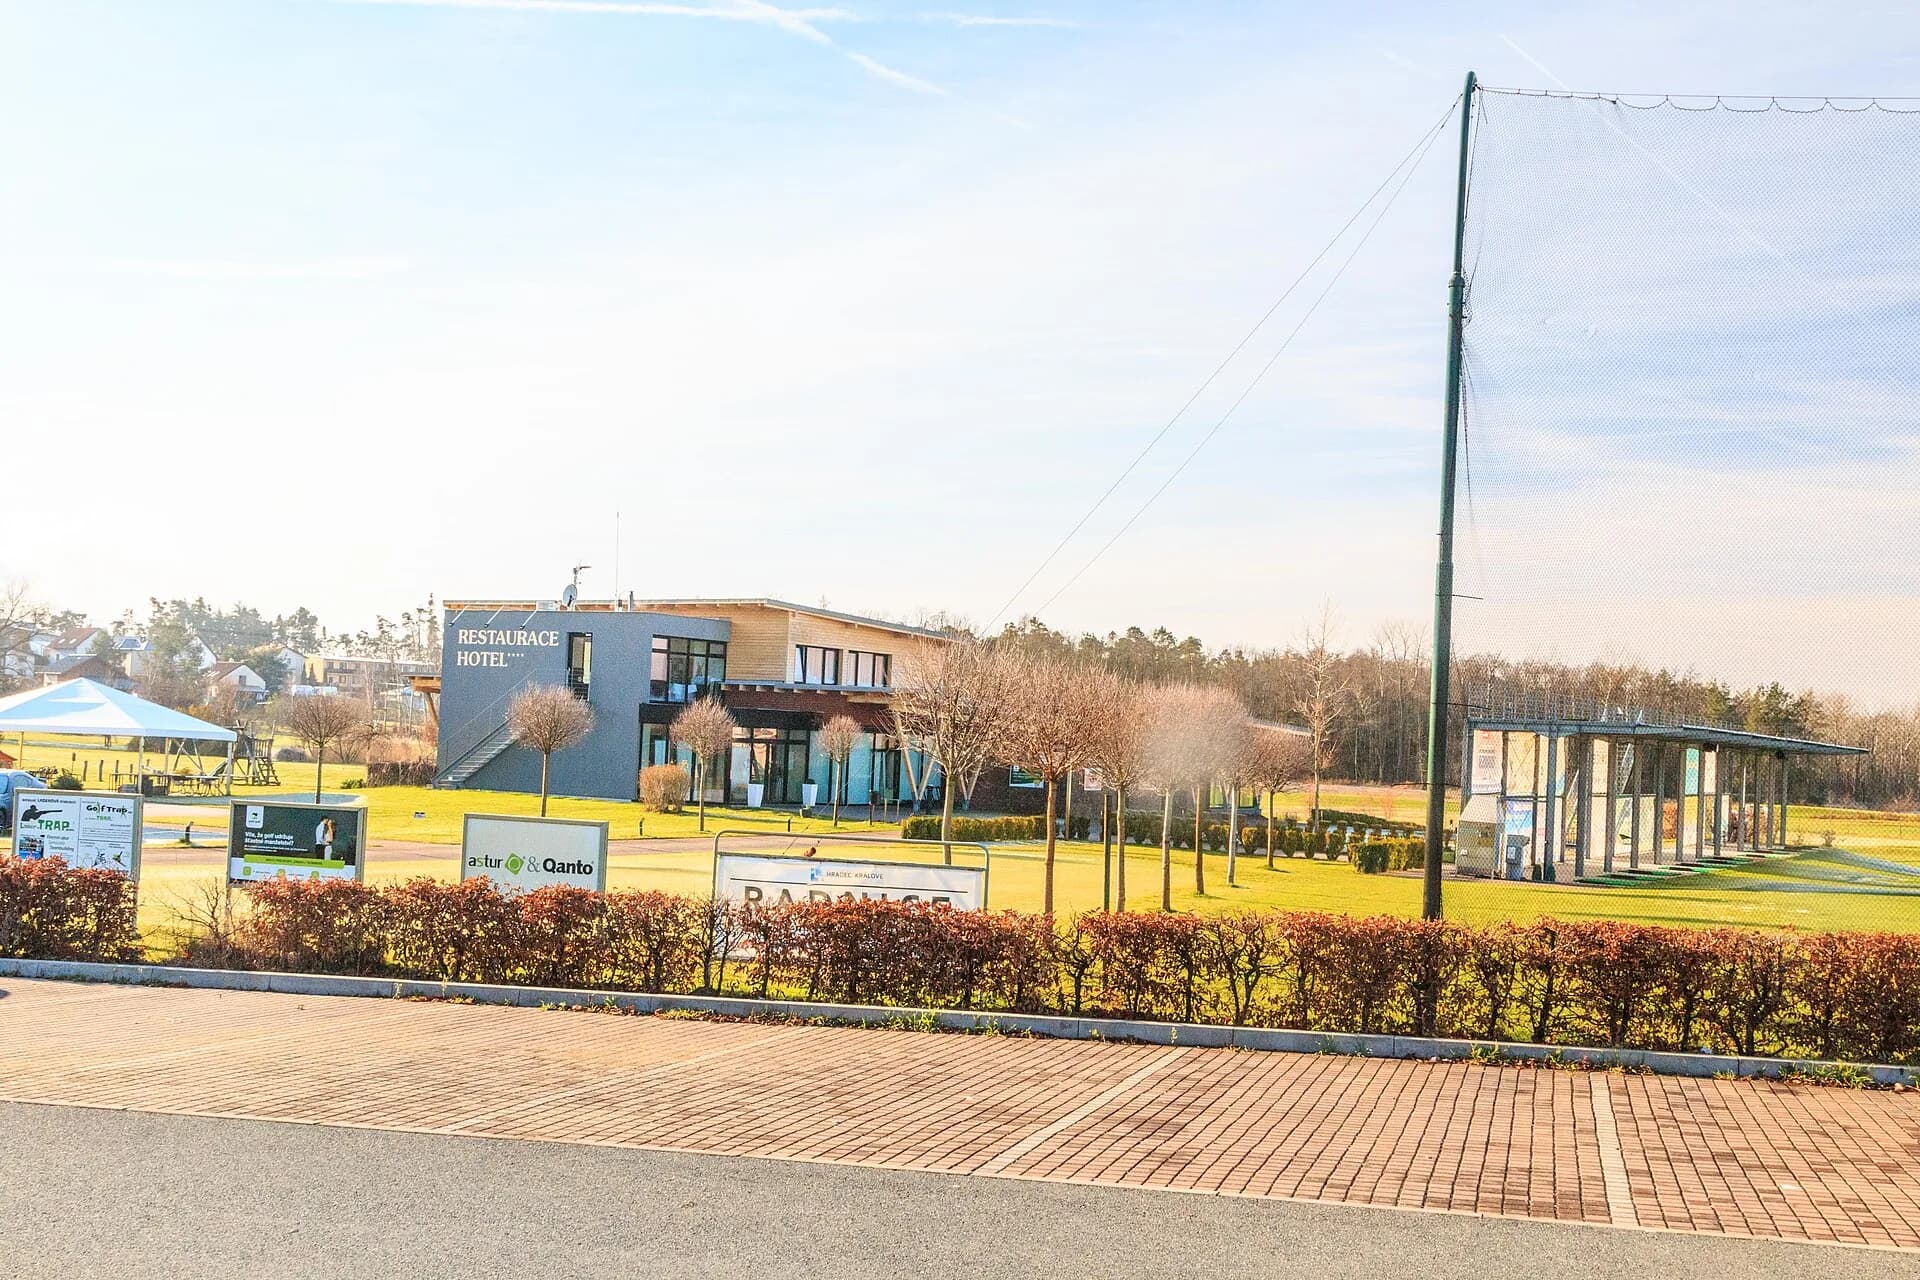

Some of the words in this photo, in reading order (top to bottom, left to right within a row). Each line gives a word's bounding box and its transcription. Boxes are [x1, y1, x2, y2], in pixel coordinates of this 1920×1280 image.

[458, 629, 559, 646] RESTAURACE
[457, 651, 508, 667] HOTEL
[38, 819, 70, 831] TRAP
[468, 855, 503, 869] astur
[527, 856, 540, 873] &
[542, 858, 593, 875] Qanto
